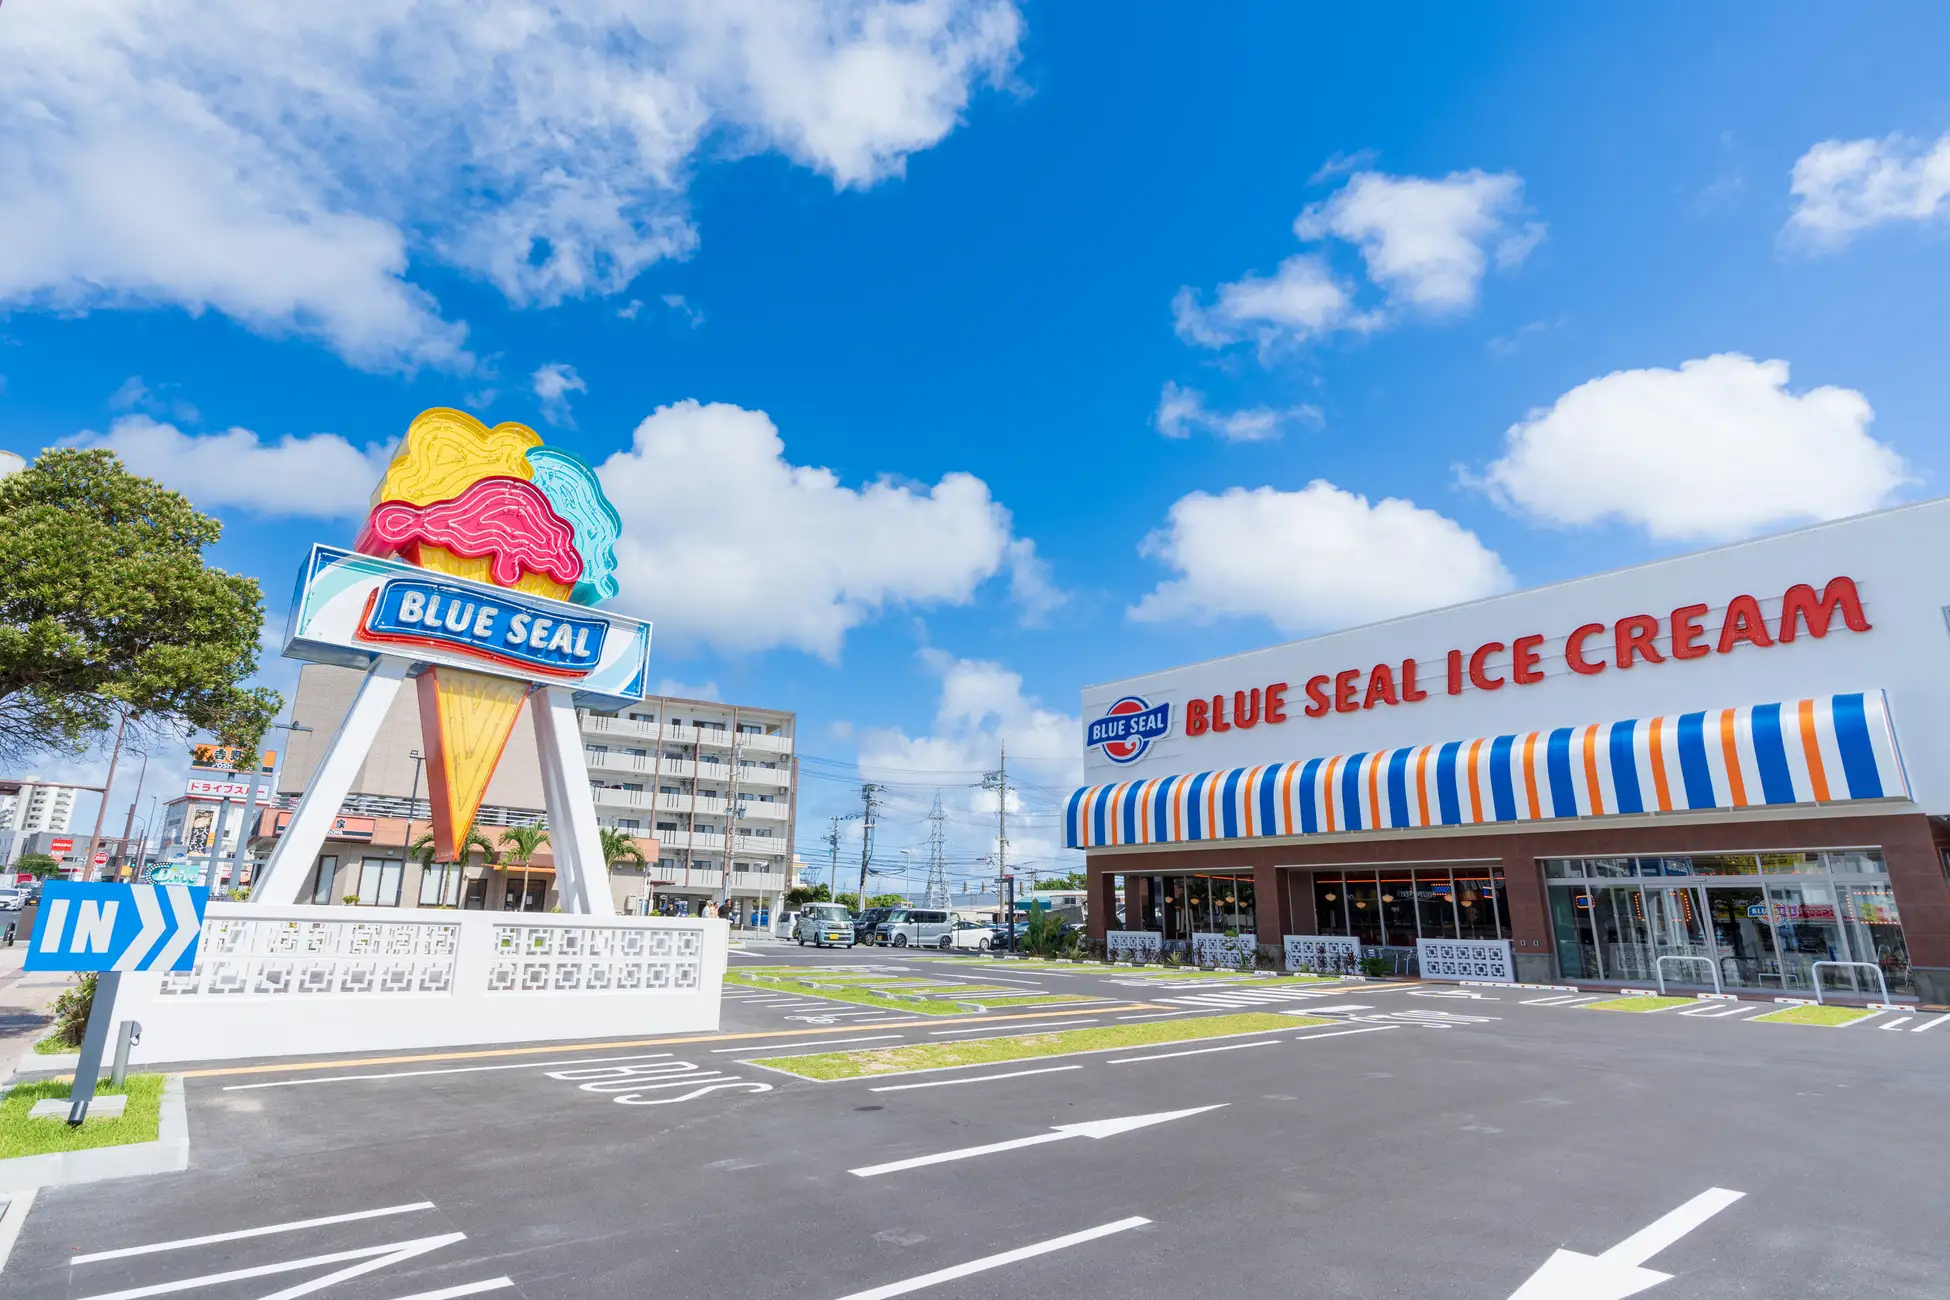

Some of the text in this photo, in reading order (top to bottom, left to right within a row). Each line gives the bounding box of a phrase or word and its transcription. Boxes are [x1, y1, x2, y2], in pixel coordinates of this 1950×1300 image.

[399, 590, 591, 657] BLUE SEAL
[1185, 575, 1873, 737] BLUE SEAL ICE CREAM
[1093, 713, 1164, 740] BLUE SEAL
[40, 899, 119, 954] IN
[542, 1060, 774, 1105] BUS
